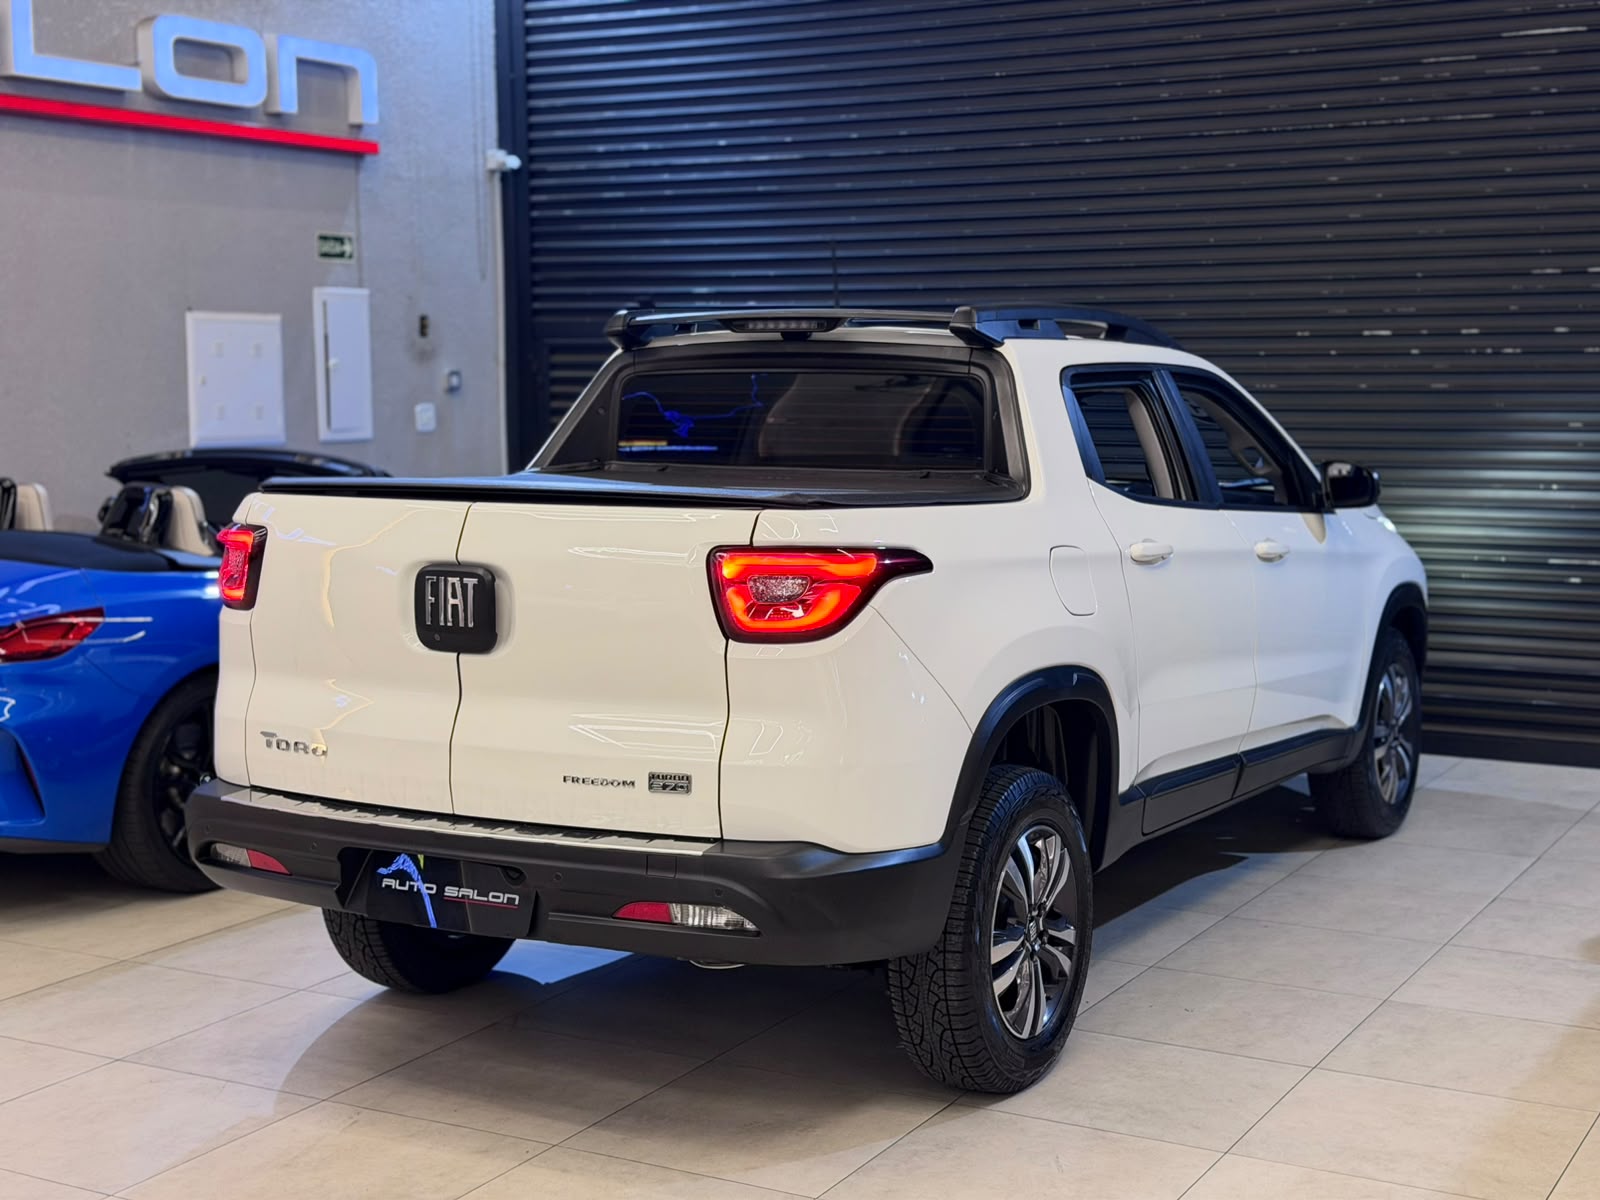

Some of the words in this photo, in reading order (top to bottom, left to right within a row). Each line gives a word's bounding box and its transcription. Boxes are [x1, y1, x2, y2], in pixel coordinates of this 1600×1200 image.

[425, 575, 479, 628] FIAT
[260, 731, 328, 757] TORO
[562, 775, 636, 788] FREEDOM
[382, 878, 437, 894] AUTO
[444, 886, 520, 905] SALON
